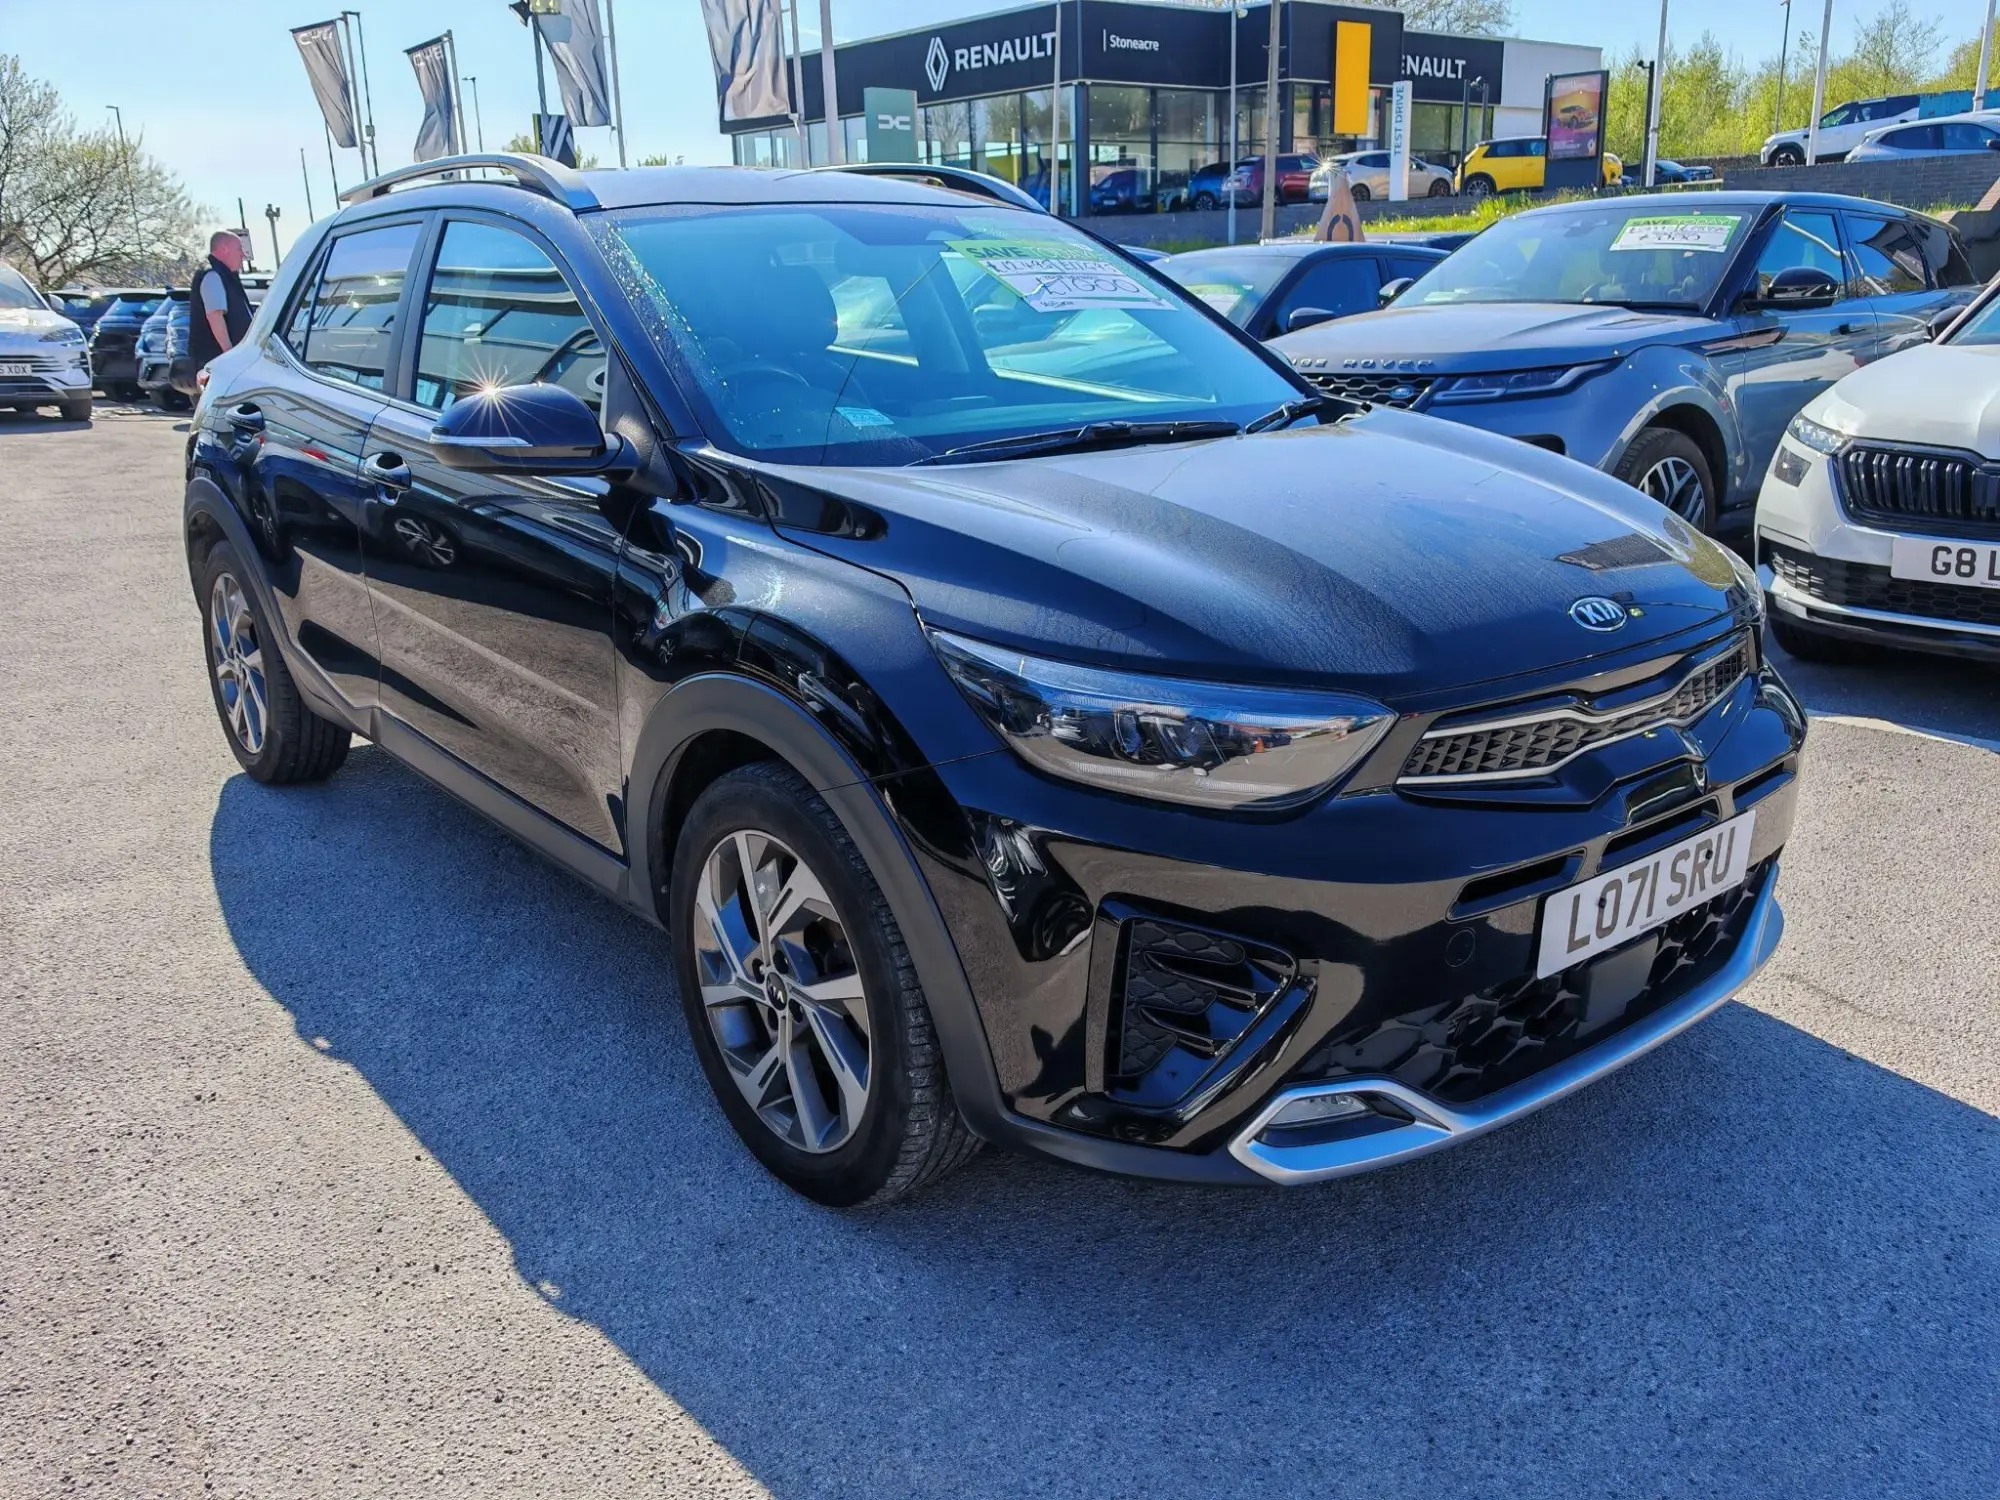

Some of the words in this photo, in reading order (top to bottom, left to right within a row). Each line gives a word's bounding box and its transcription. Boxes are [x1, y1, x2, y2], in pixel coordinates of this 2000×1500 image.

[955, 32, 1057, 71] RENAULT
[1110, 34, 1160, 51] Stoneacre
[1395, 86, 1404, 123] DRIVE
[1394, 128, 1403, 156] TEST
[966, 247, 1026, 259] SAVE
[1342, 358, 1436, 371] ROVER
[1931, 545, 1977, 578] G8
[1577, 600, 1624, 625] KIA
[1567, 860, 1661, 955] LO71
[1666, 826, 1736, 908] SRU
